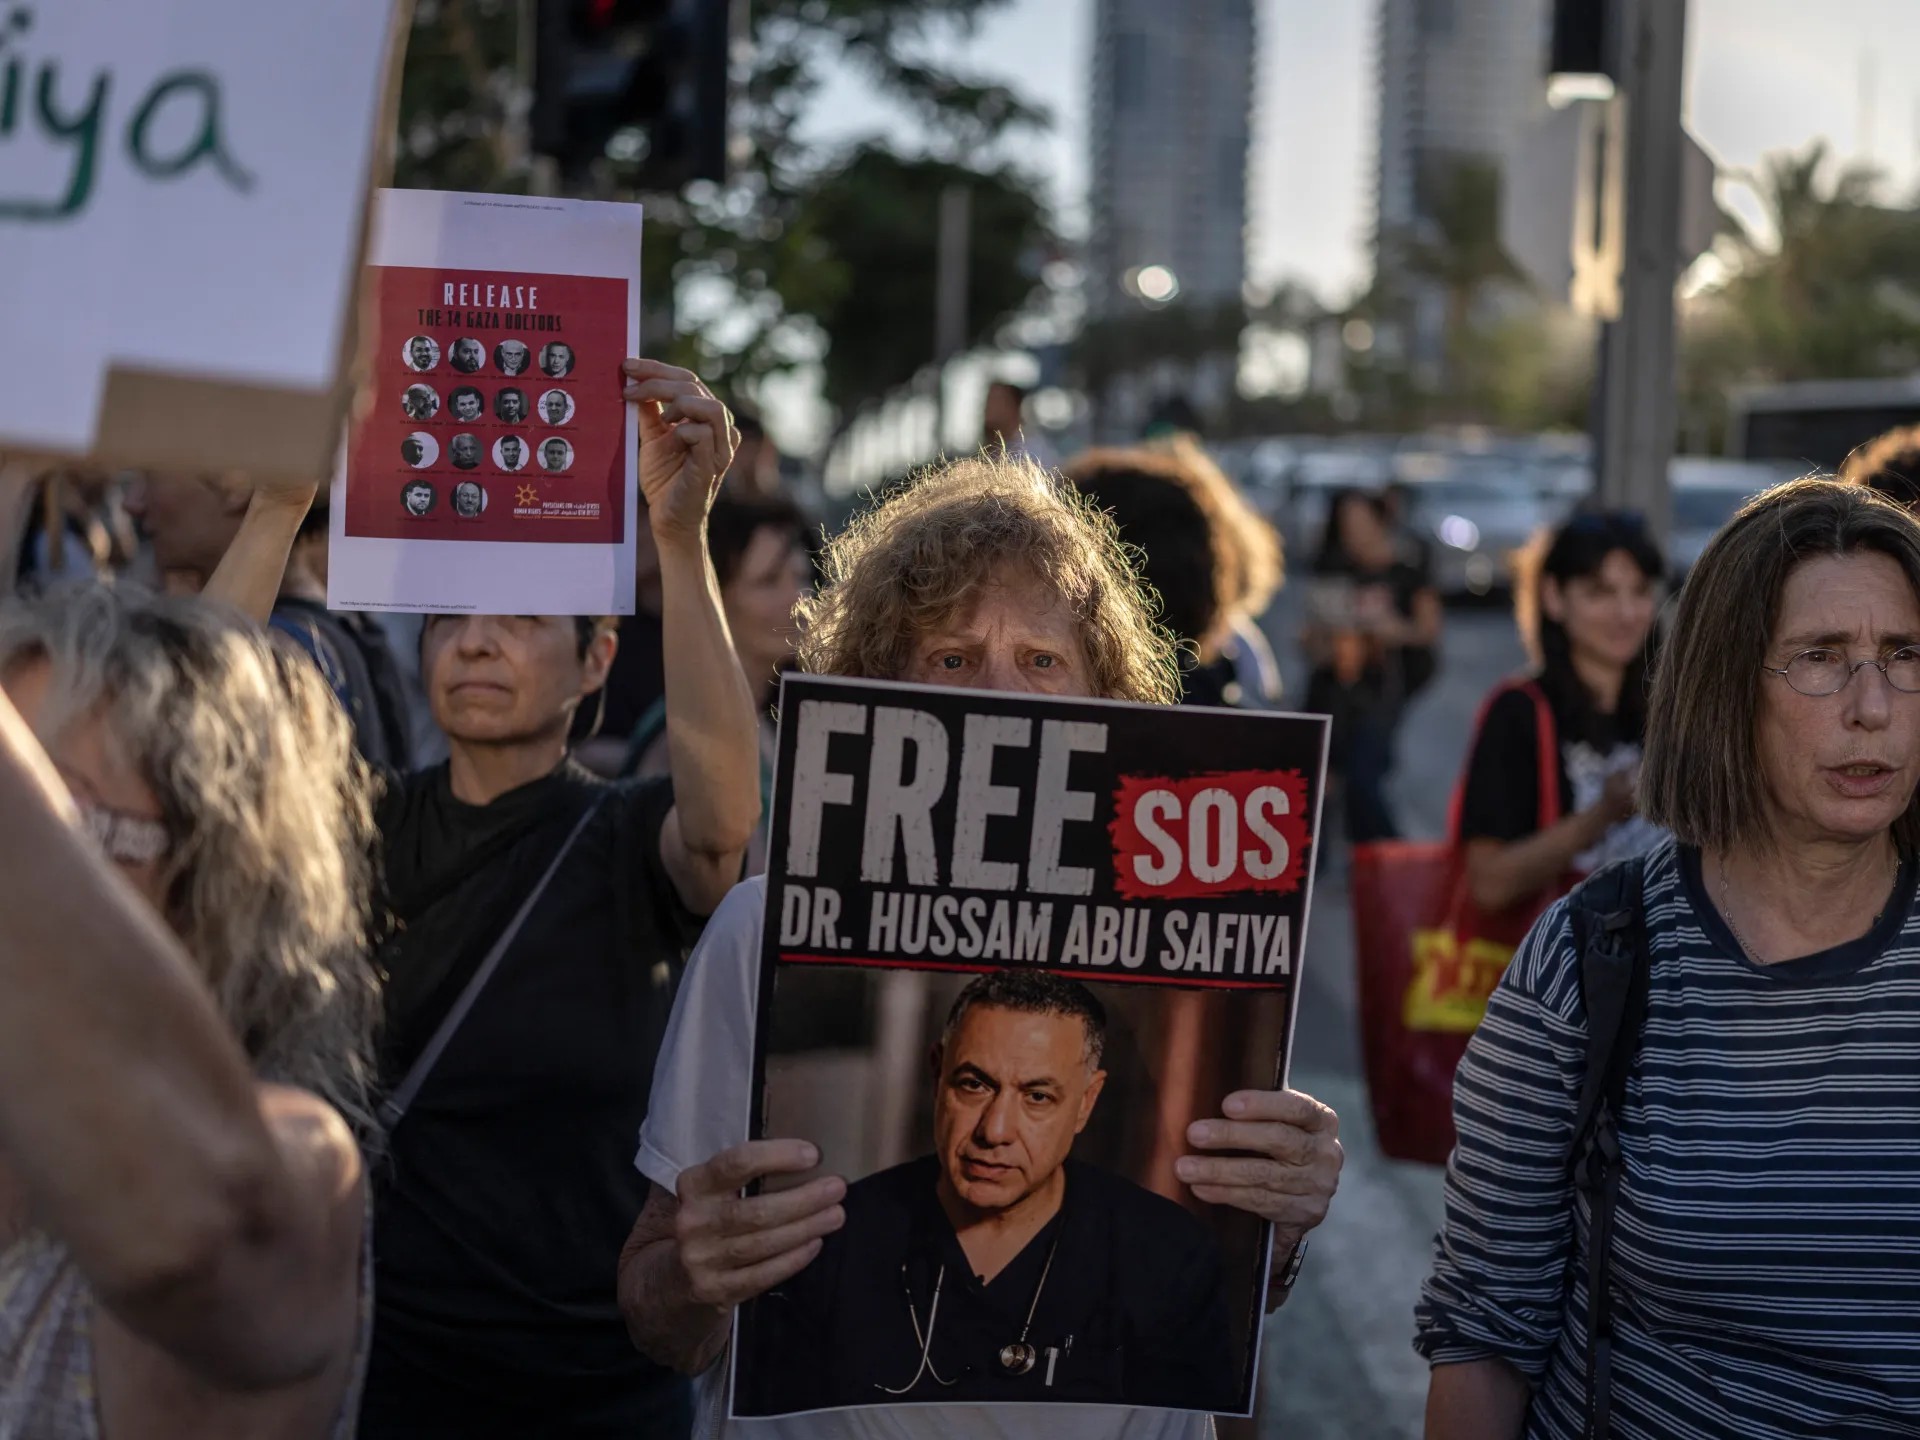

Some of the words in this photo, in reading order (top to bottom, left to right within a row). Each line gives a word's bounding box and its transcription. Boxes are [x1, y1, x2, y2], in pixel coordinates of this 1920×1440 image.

[0, 6, 256, 223] iya
[417, 309, 442, 327] THE
[447, 310, 462, 328] 14
[466, 311, 500, 330] GAZA
[505, 313, 562, 332] DOCTORS
[443, 282, 538, 310] RELEASE
[785, 699, 1109, 897] FREE
[1132, 785, 1291, 887] SOS
[778, 885, 852, 951] DR.
[867, 891, 1053, 963] HUSSAM
[1060, 904, 1151, 969] ABU
[1159, 908, 1291, 976] SAFIYA
